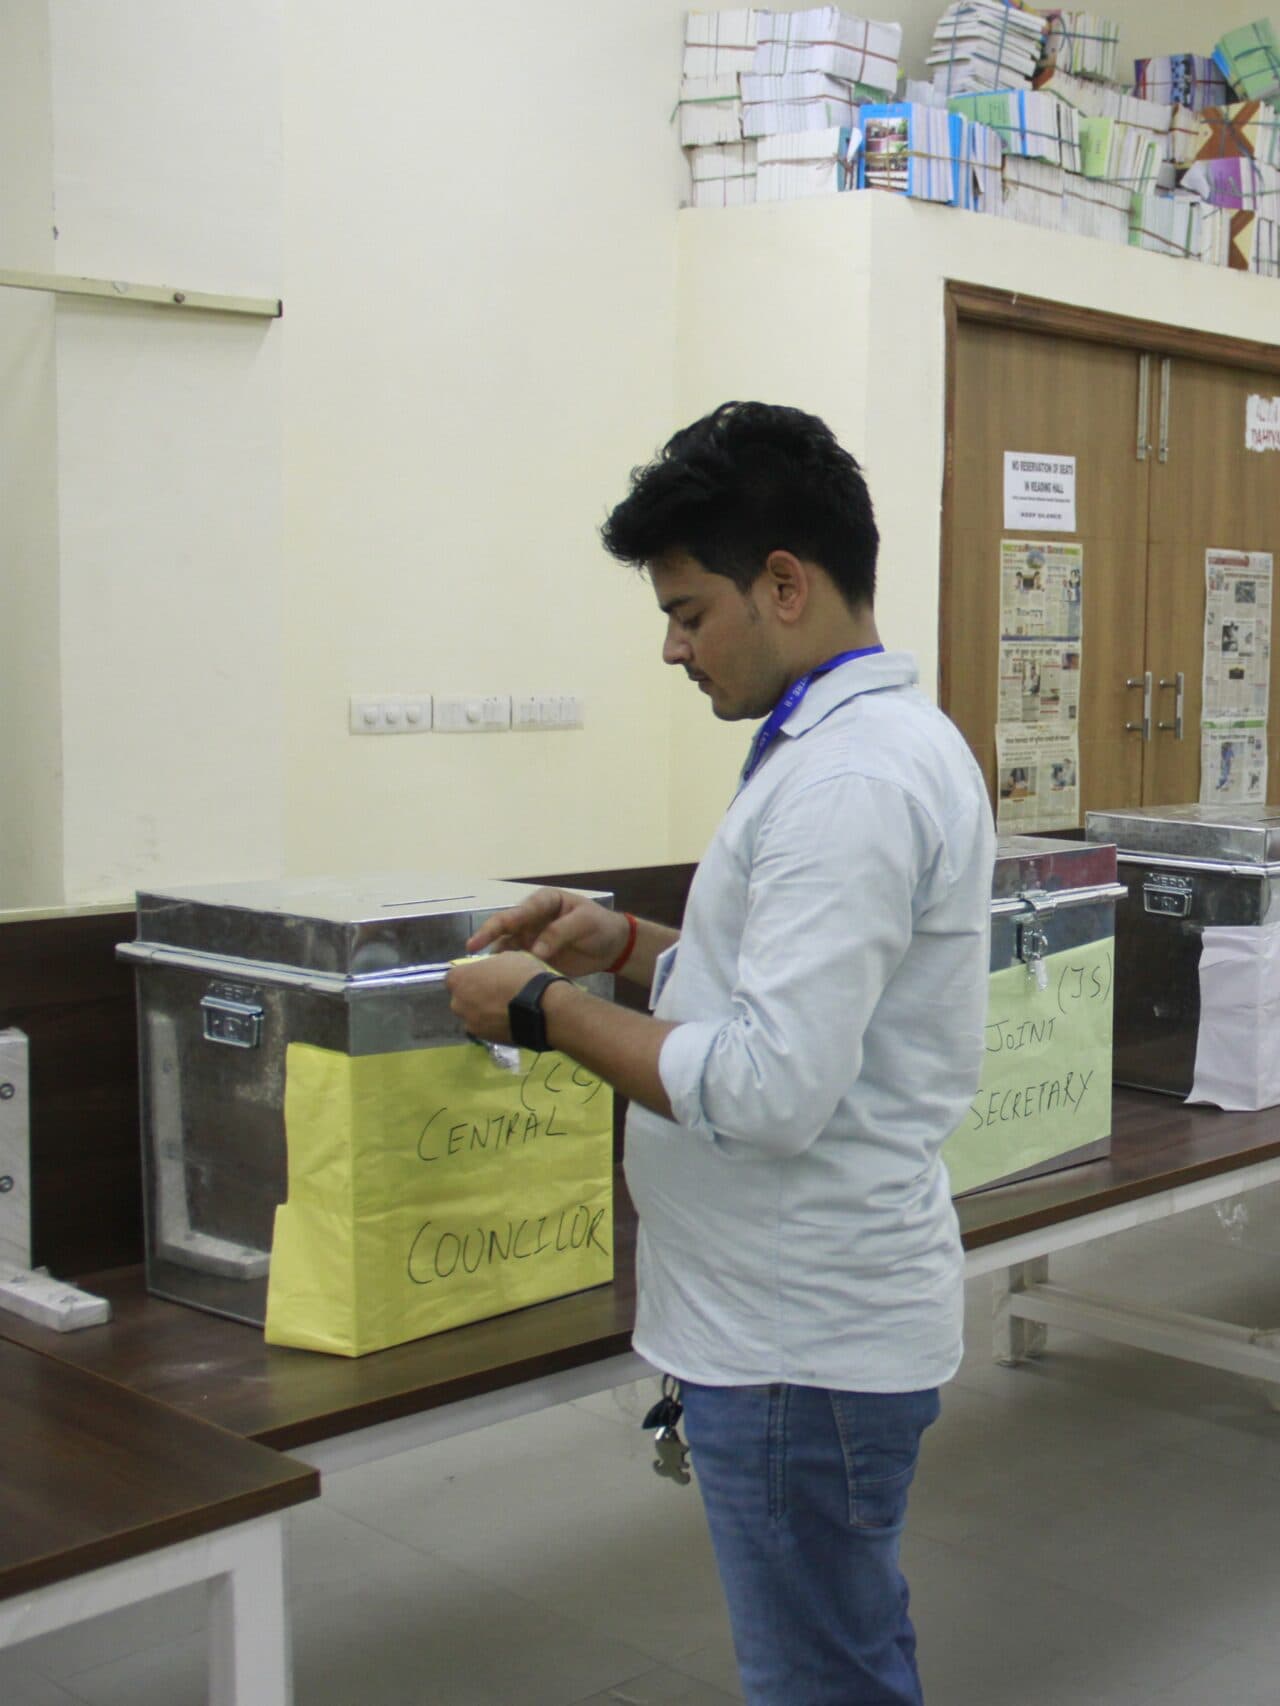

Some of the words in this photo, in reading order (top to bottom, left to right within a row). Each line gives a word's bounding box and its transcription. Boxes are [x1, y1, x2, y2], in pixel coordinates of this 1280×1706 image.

[1057, 952, 1112, 1014] (JS)
[970, 1069, 1094, 1130] SECRETARY
[417, 1106, 568, 1162] CENTRAL
[407, 1205, 609, 1285] COUNCILOR
